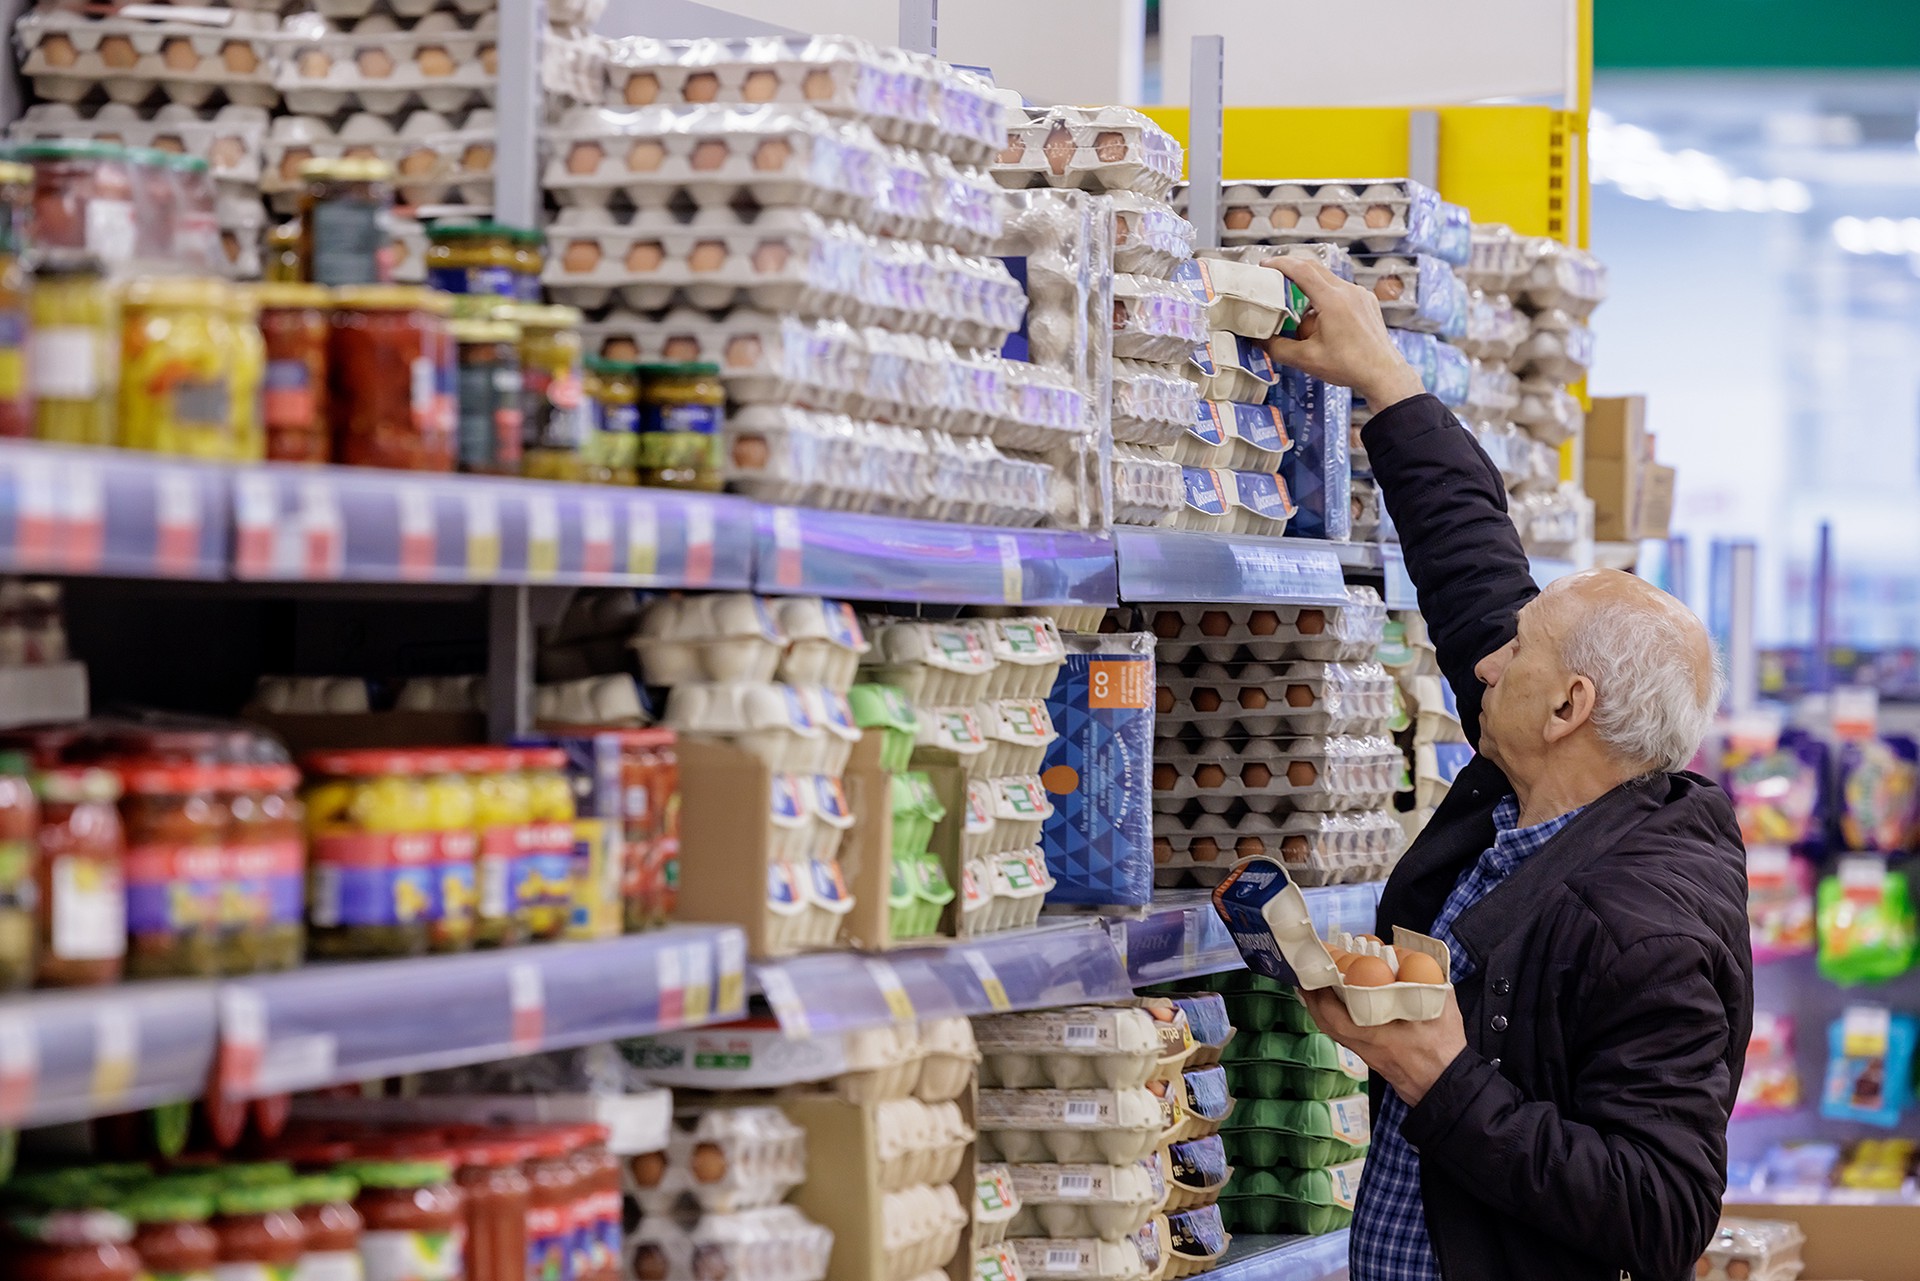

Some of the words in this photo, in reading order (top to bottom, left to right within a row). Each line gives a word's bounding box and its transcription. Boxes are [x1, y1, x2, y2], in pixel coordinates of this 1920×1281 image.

[1301, 413, 1313, 442] ШТУК
[1114, 731, 1132, 778] УПАКОВКЕ
[1119, 790, 1131, 816] ШТУК
